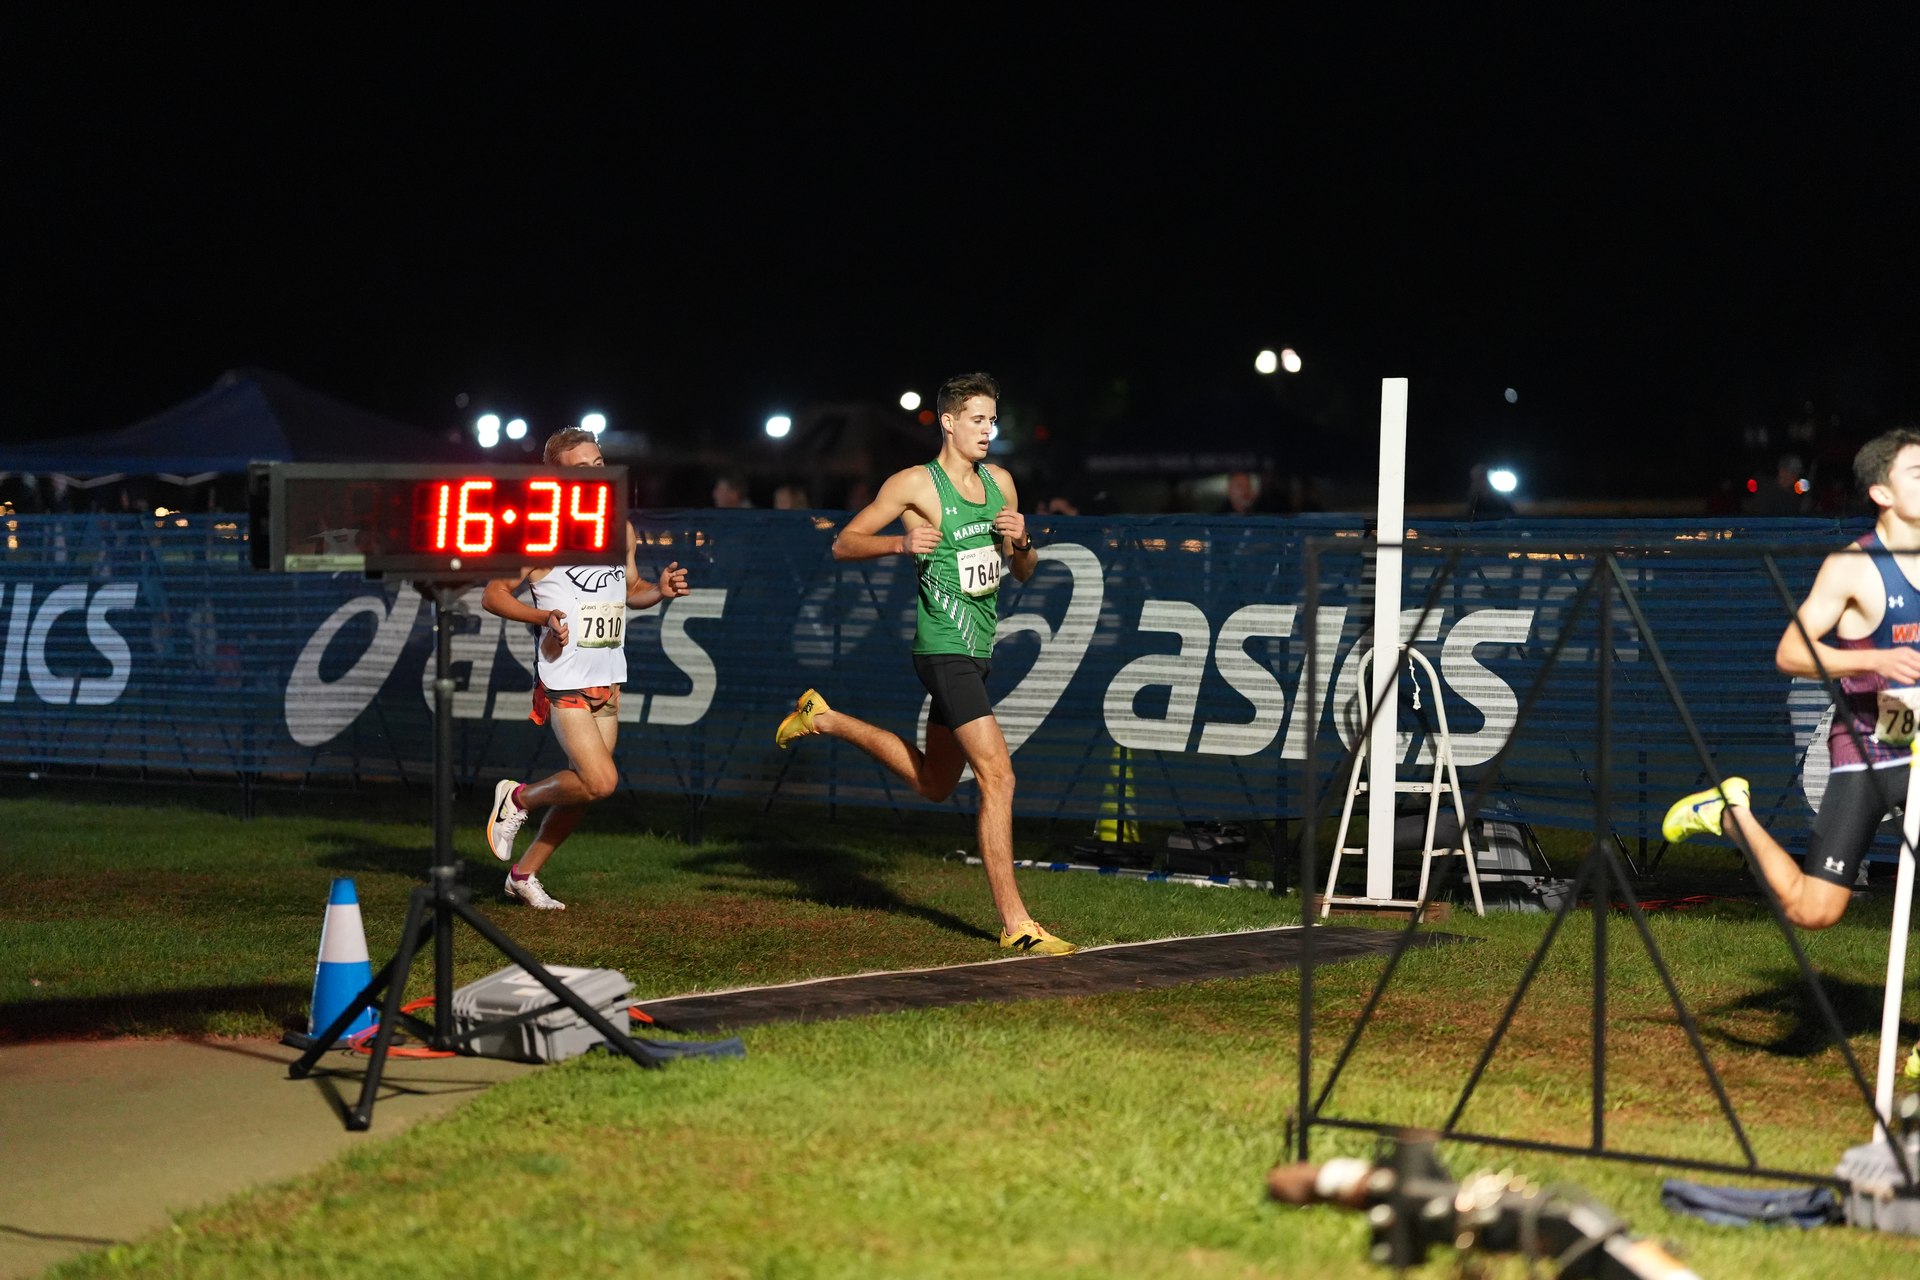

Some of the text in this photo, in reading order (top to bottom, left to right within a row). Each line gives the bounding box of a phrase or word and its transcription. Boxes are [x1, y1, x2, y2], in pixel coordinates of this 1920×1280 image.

[953, 523, 992, 541] MANSFI
[583, 616, 622, 638] 7810
[1892, 623, 1920, 643] WA
[1886, 709, 1920, 735] 78
